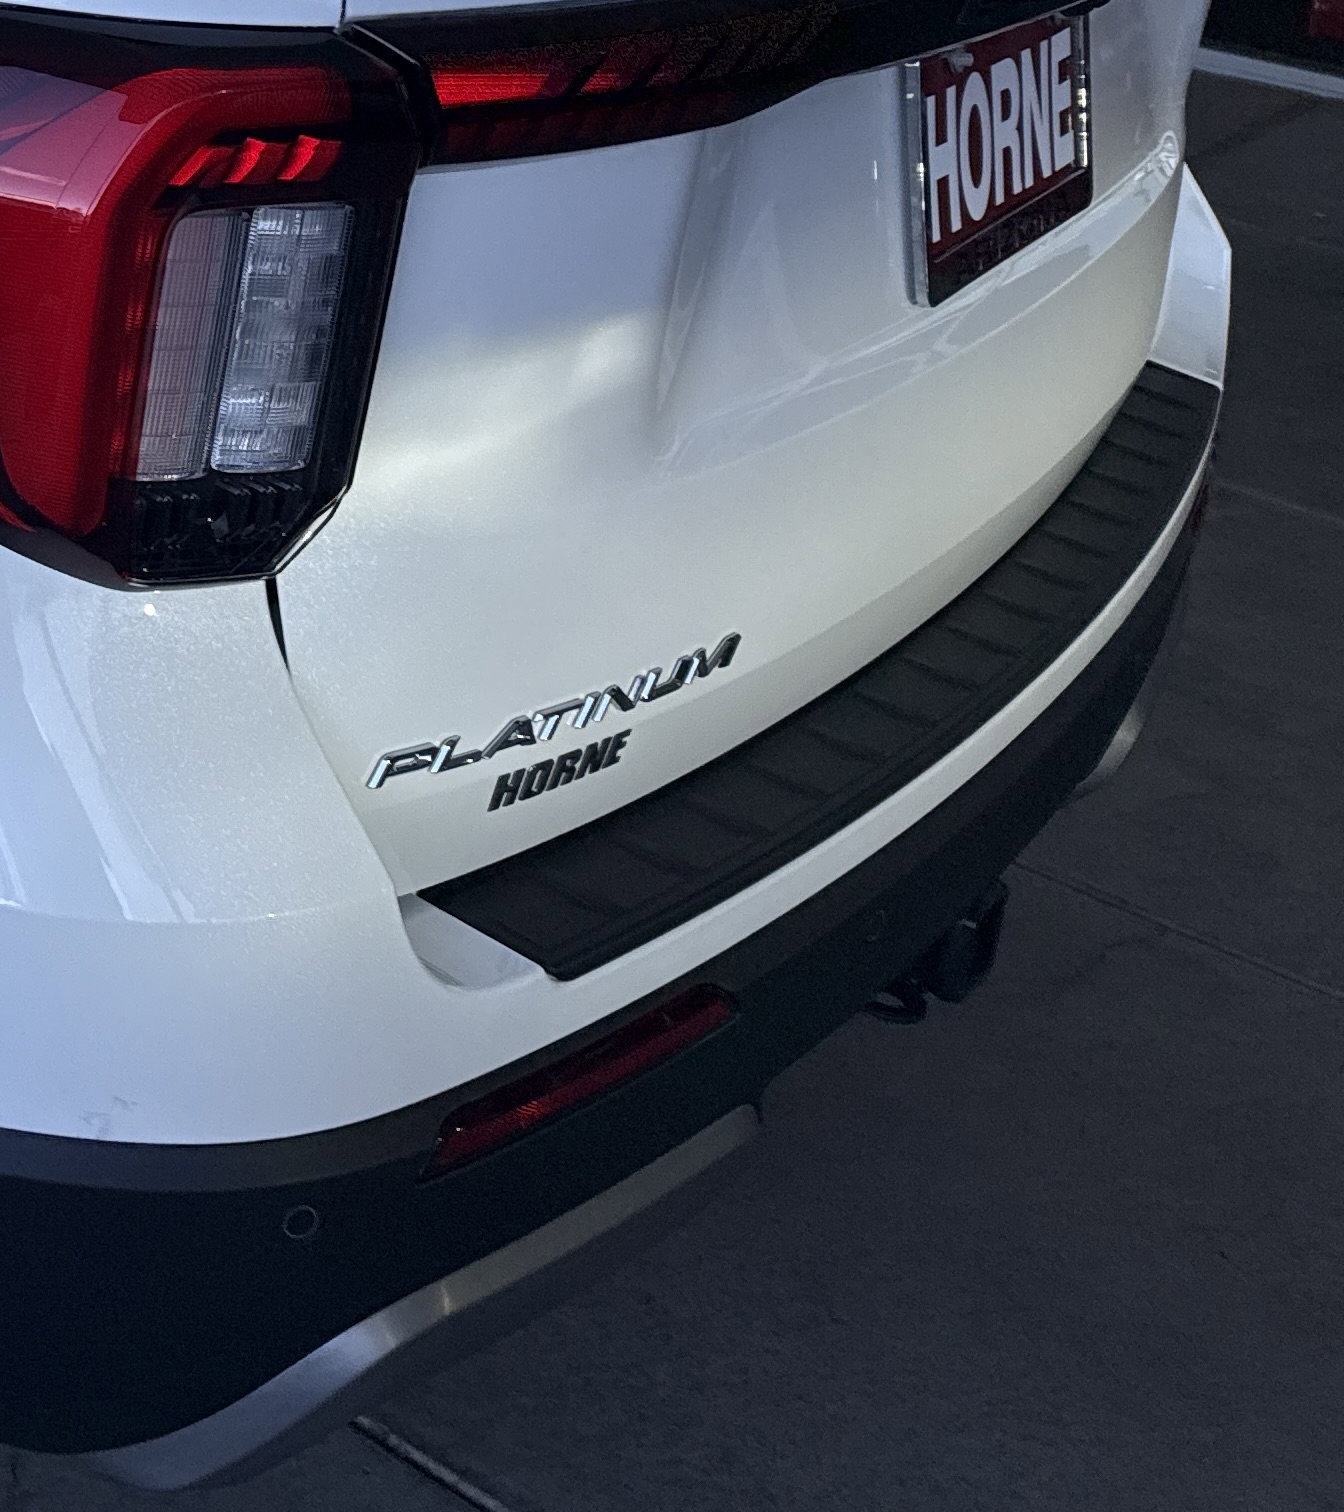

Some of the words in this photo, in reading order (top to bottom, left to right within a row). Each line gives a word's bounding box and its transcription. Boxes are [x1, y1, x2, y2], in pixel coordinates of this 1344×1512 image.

[925, 26, 1076, 244] HORNE
[365, 631, 743, 790] PLATINUM
[486, 728, 633, 813] HORNE
